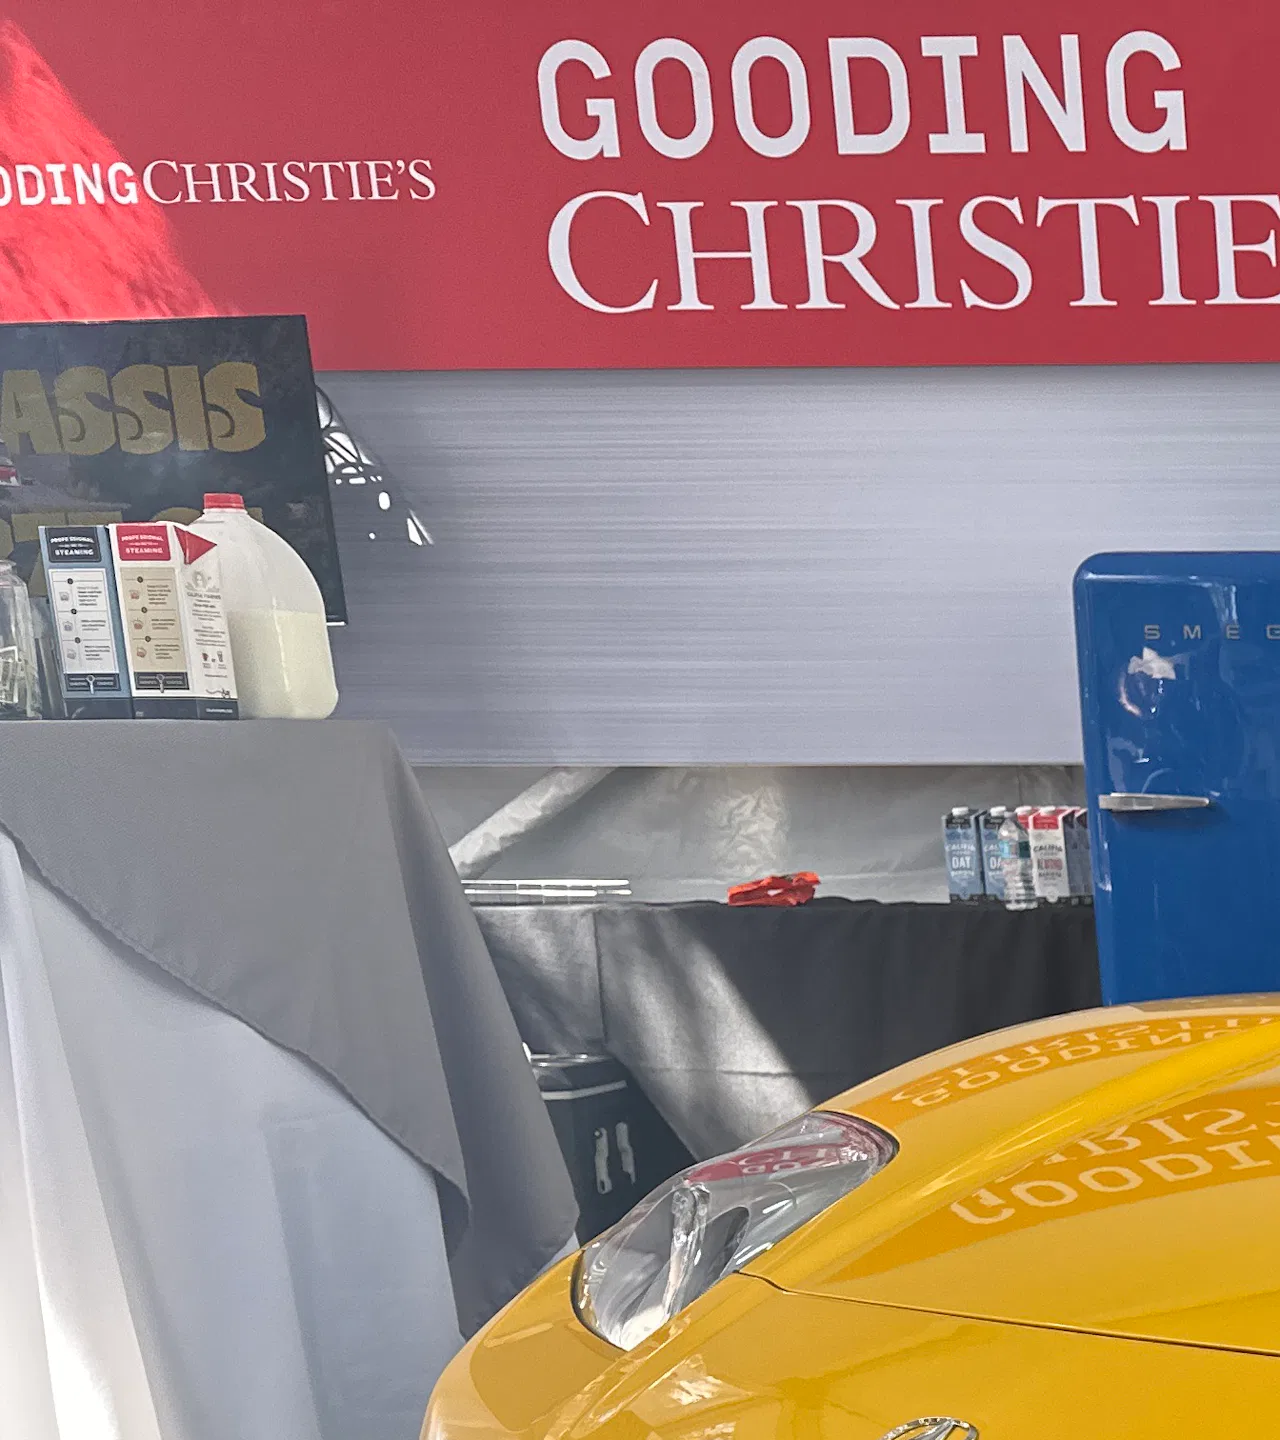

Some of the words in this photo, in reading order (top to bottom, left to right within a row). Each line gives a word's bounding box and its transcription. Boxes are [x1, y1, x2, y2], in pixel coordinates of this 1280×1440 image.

[538, 31, 1188, 159] GOODING
[1, 362, 266, 455] ASSIS
[952, 856, 972, 869] OAT
